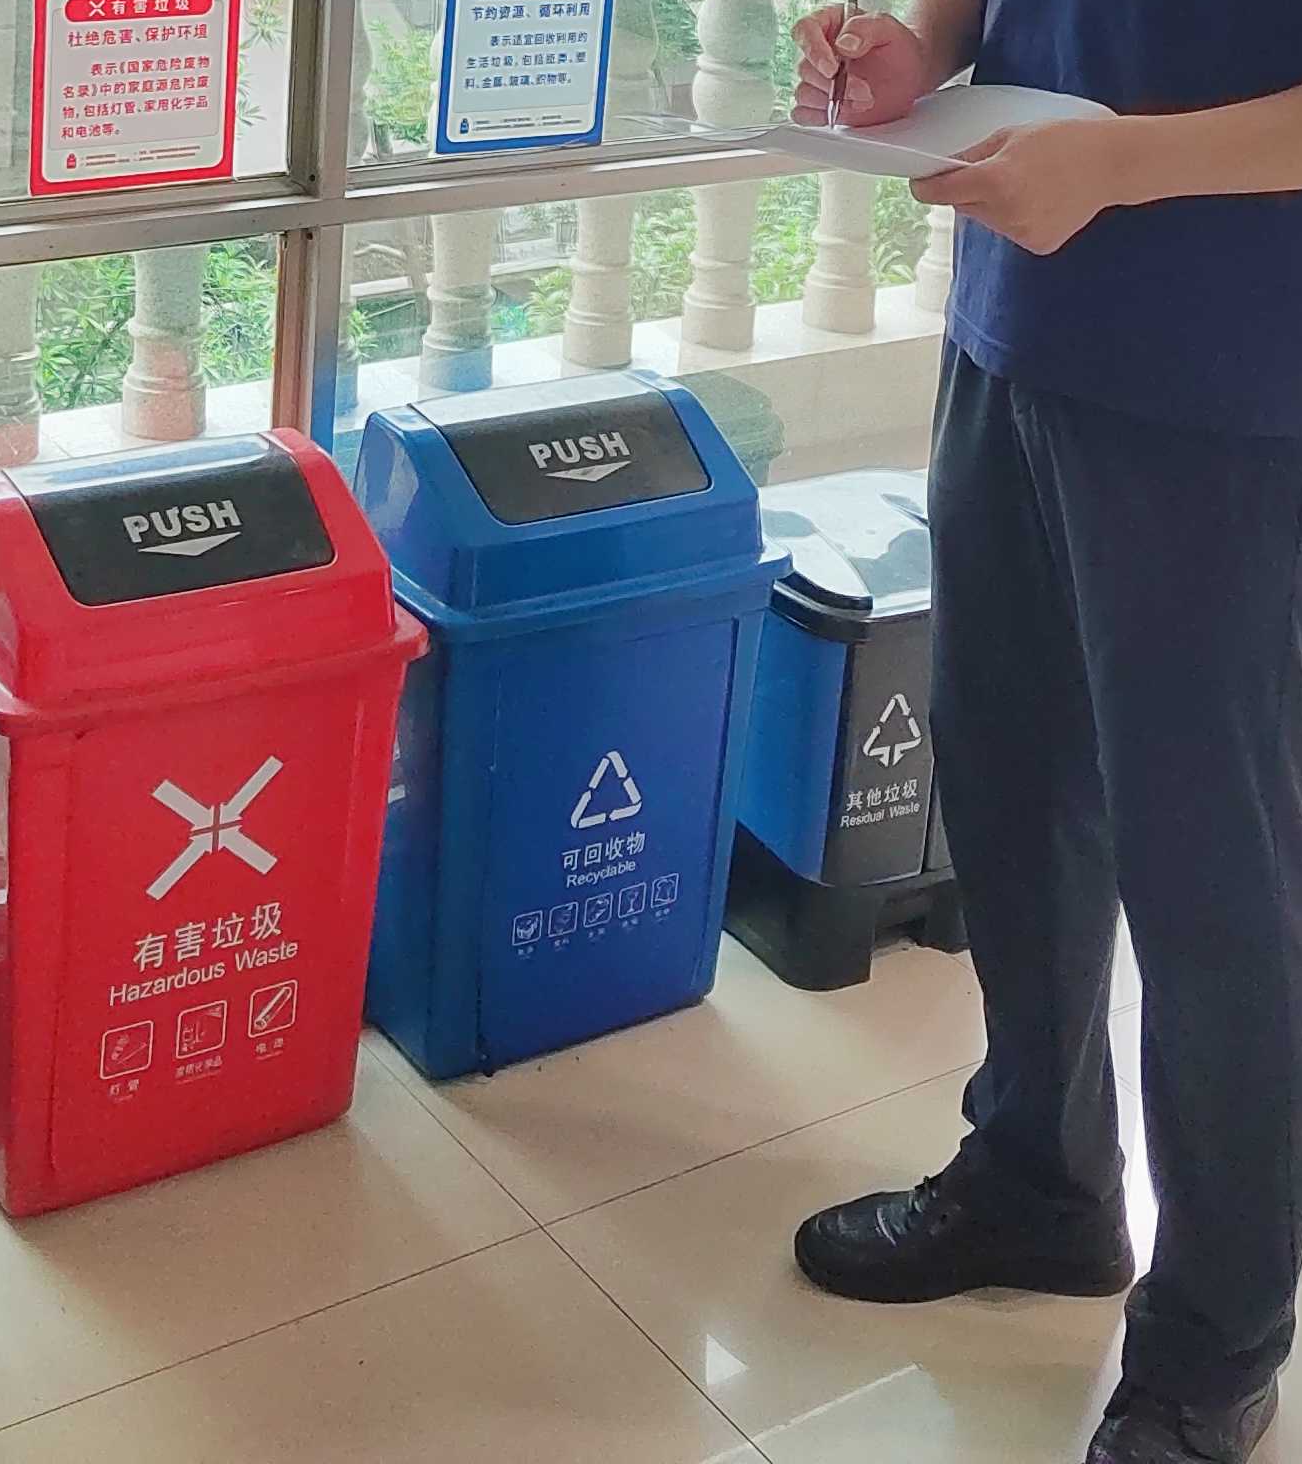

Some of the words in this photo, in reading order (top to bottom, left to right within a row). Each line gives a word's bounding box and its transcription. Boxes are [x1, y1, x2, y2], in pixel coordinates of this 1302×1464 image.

[528, 432, 630, 469] PUSH
[123, 499, 242, 543] PUSH
[839, 808, 884, 828] Residual
[889, 801, 921, 818] Waste
[846, 779, 918, 812] 其他垃圾
[562, 832, 646, 871] 可回收物
[566, 860, 636, 888] Recyclable
[133, 902, 282, 972] 有害垃圾
[109, 962, 225, 1006] Hazardous
[235, 940, 298, 971] Waste
